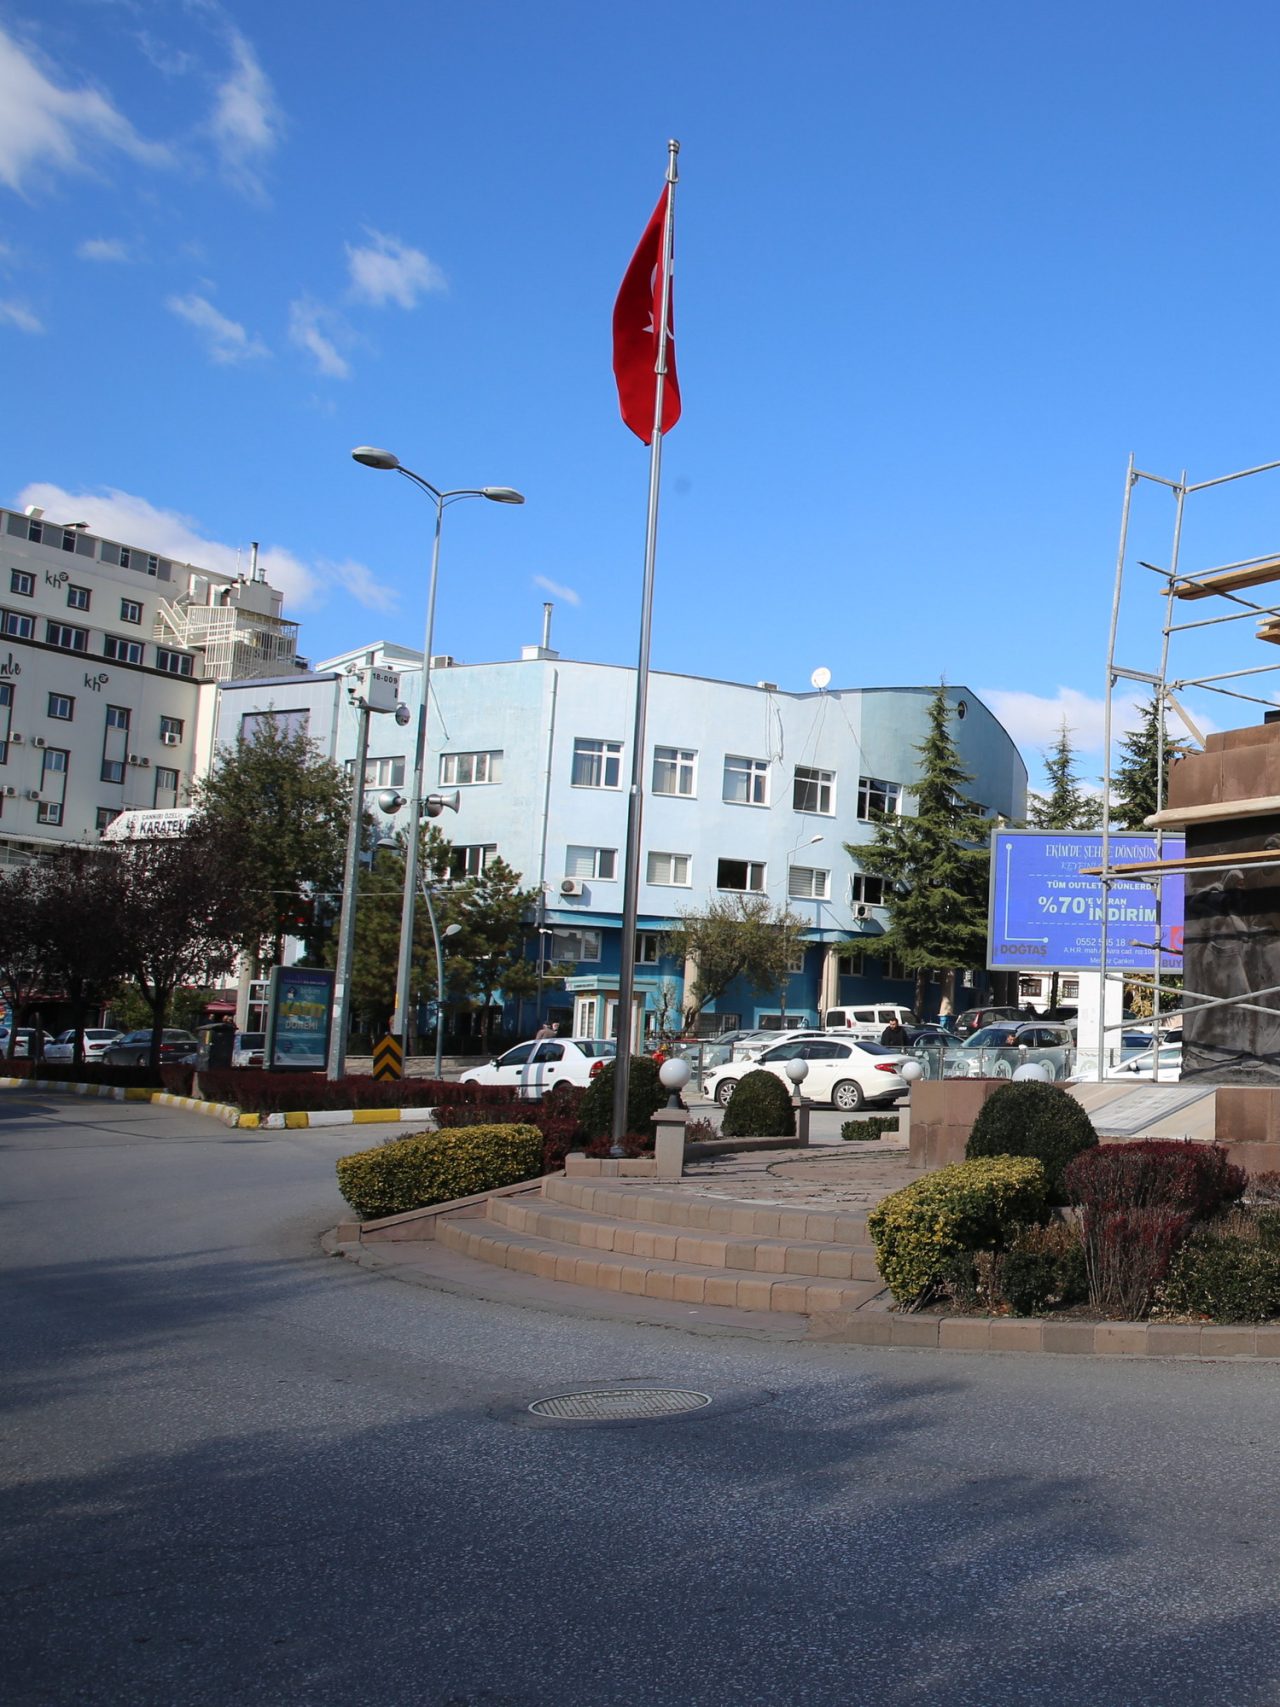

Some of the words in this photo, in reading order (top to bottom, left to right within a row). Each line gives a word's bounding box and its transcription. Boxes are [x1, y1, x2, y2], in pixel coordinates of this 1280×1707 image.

[1083, 845, 1113, 859] ŞEHE
[1047, 880, 1065, 889] TÜM
[1068, 881, 1102, 890] OUTLET
[1104, 881, 1157, 891] RÜNLERD
[1089, 905, 1157, 921] İNDİRİM
[1097, 938, 1114, 946] 55
[1000, 943, 1047, 956] DOĞTAŞ
